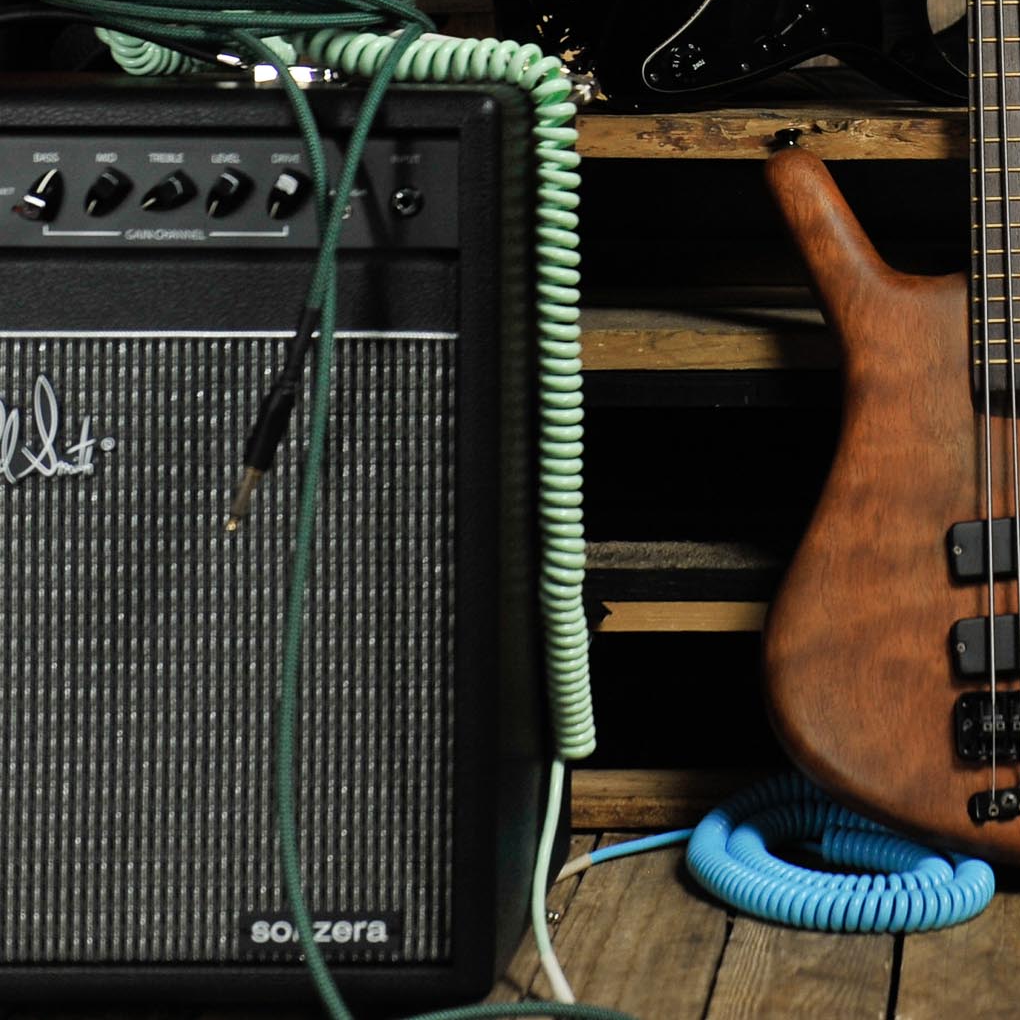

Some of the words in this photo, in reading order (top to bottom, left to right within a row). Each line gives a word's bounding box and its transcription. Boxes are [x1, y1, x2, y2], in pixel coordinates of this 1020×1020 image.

[33, 152, 60, 163] BASS
[95, 152, 118, 163] MID
[148, 152, 184, 163] TREBLE
[210, 153, 241, 164] LEVEL
[271, 153, 301, 164] DRIVE
[250, 920, 389, 943] sozera
